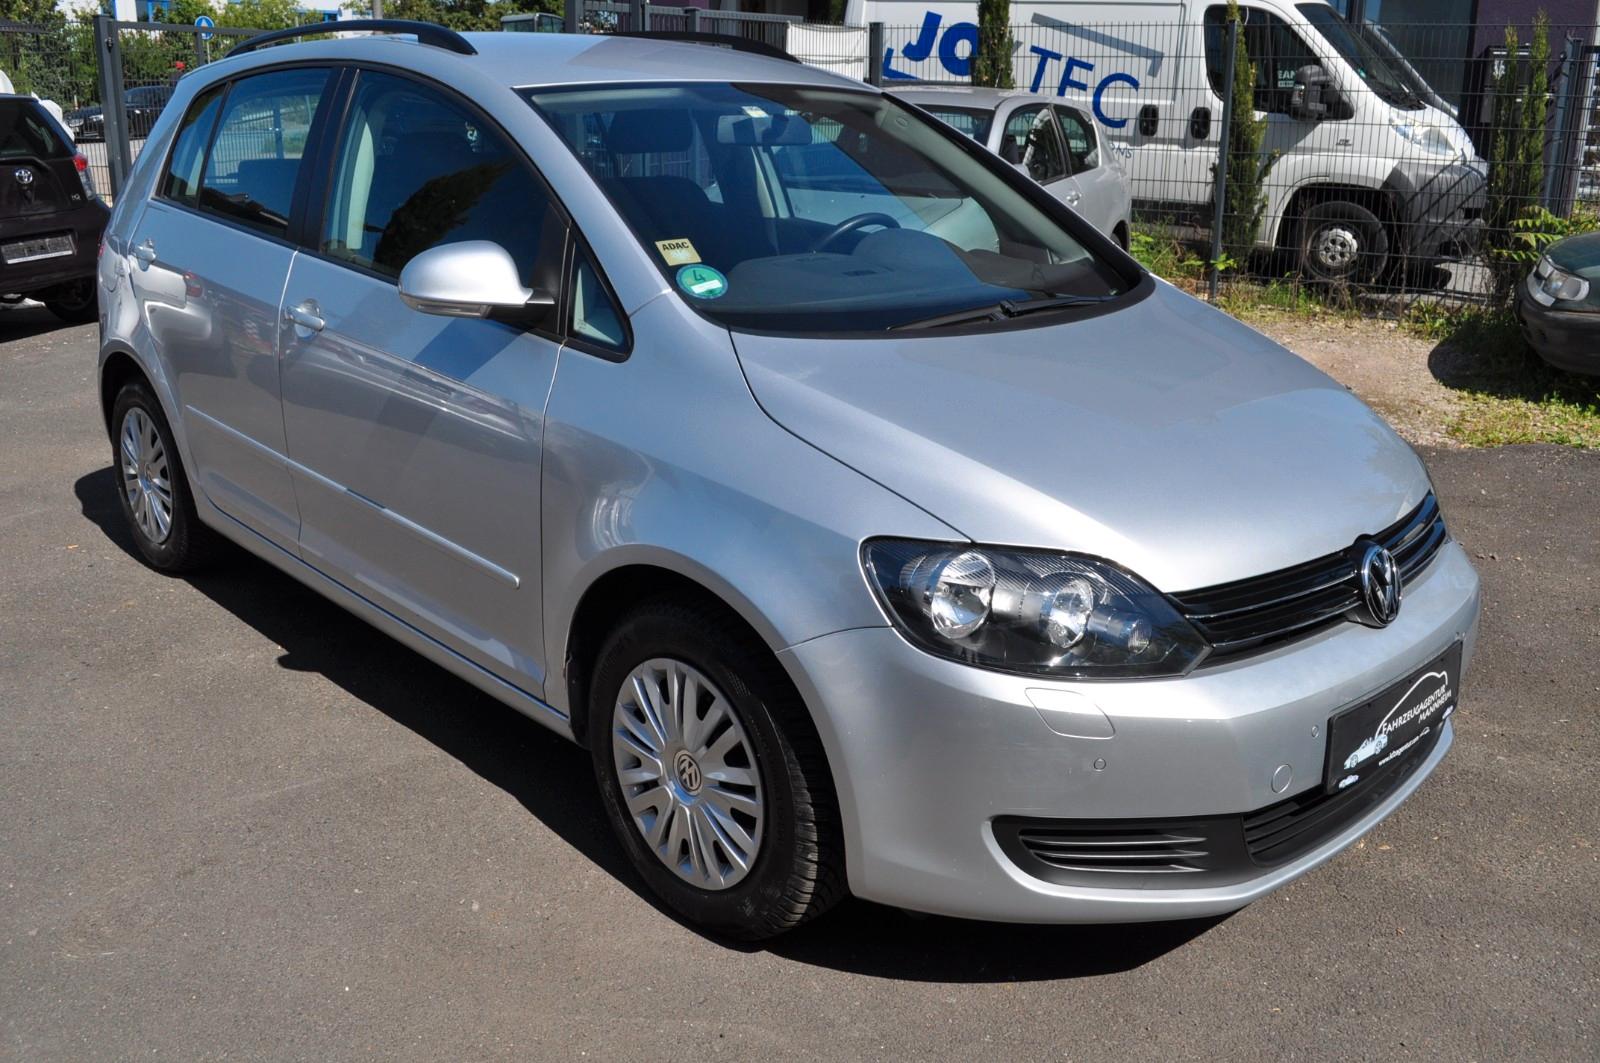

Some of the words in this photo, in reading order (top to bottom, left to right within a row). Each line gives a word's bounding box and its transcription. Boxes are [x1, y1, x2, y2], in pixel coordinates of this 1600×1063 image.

[661, 240, 690, 252] ADAC
[692, 269, 706, 283] 4
[1382, 684, 1446, 736] FAHRZEUGAGENTUR
